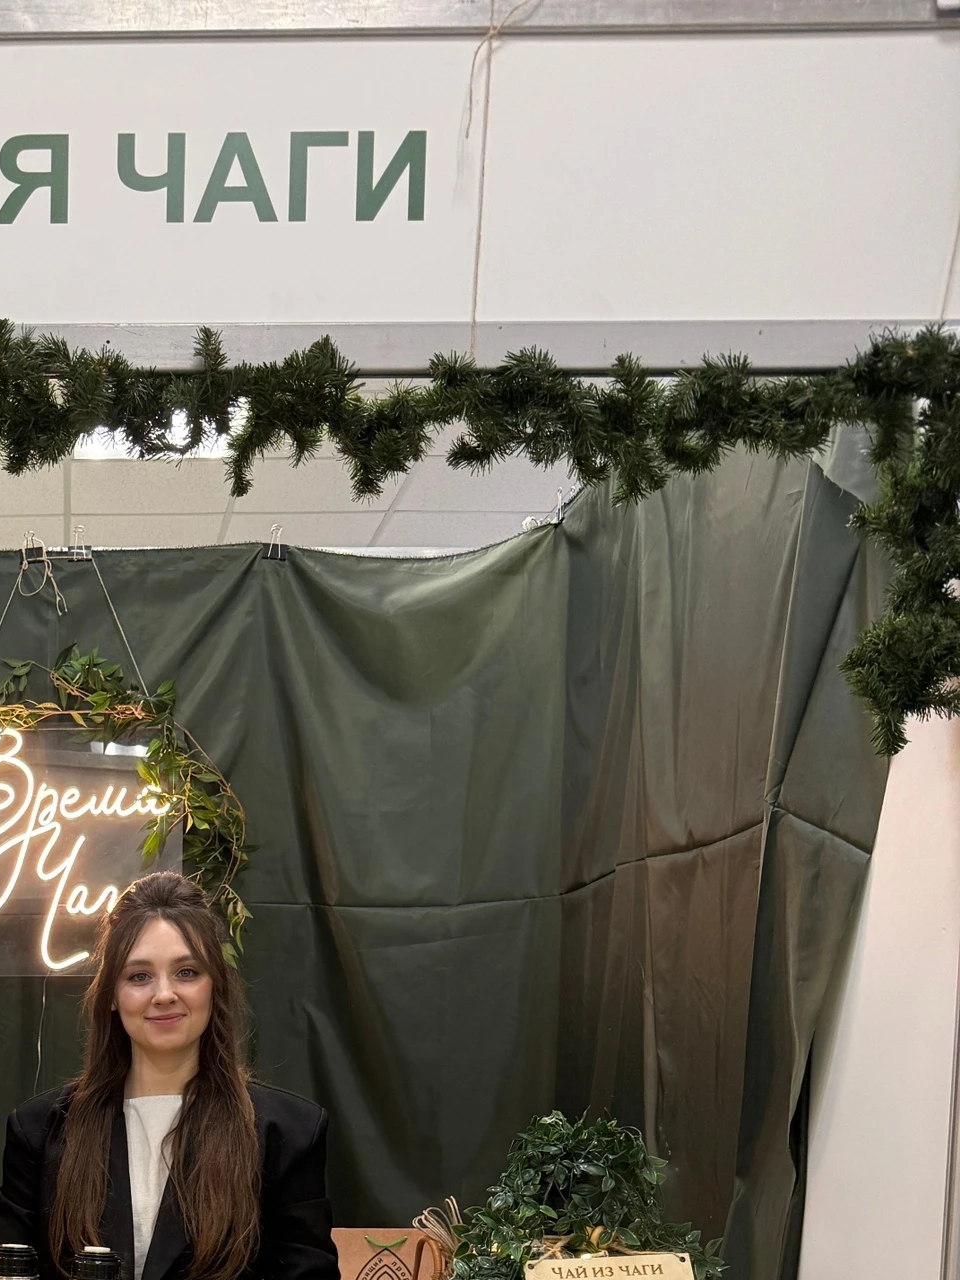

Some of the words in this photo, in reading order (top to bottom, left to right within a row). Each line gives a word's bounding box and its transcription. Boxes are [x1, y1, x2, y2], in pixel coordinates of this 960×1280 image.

[116, 129, 426, 223] ЧАГИ
[550, 1263, 588, 1280] ЧАЙ
[592, 1265, 615, 1278] ИЗ
[618, 1263, 664, 1277] ЧАГИ
